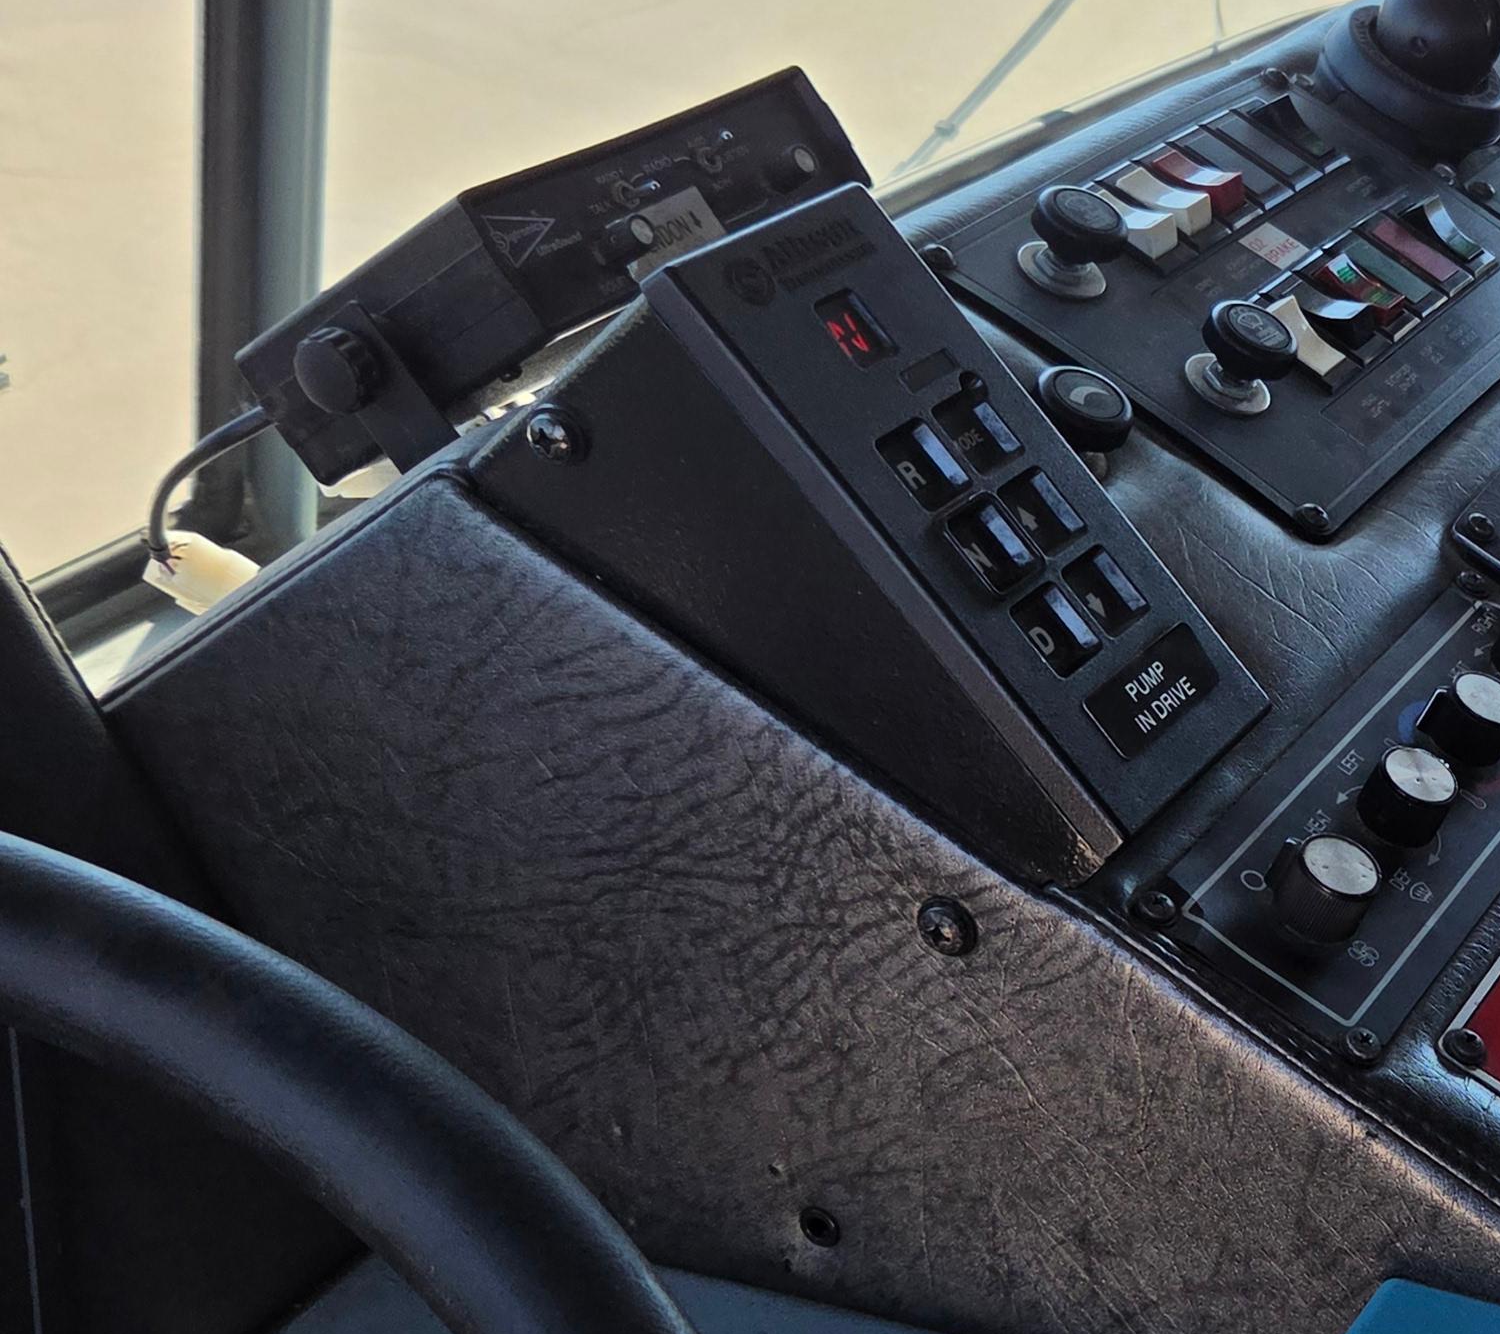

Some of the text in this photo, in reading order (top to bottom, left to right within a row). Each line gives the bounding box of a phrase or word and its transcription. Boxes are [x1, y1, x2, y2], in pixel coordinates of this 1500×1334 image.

[953, 428, 985, 452] ODE
[897, 460, 927, 490] R
[964, 542, 993, 573] N
[1028, 626, 1056, 657] D
[1124, 660, 1165, 703] PUMP
[1134, 675, 1197, 734] IN DRIVE
[1337, 748, 1366, 776] LEFT
